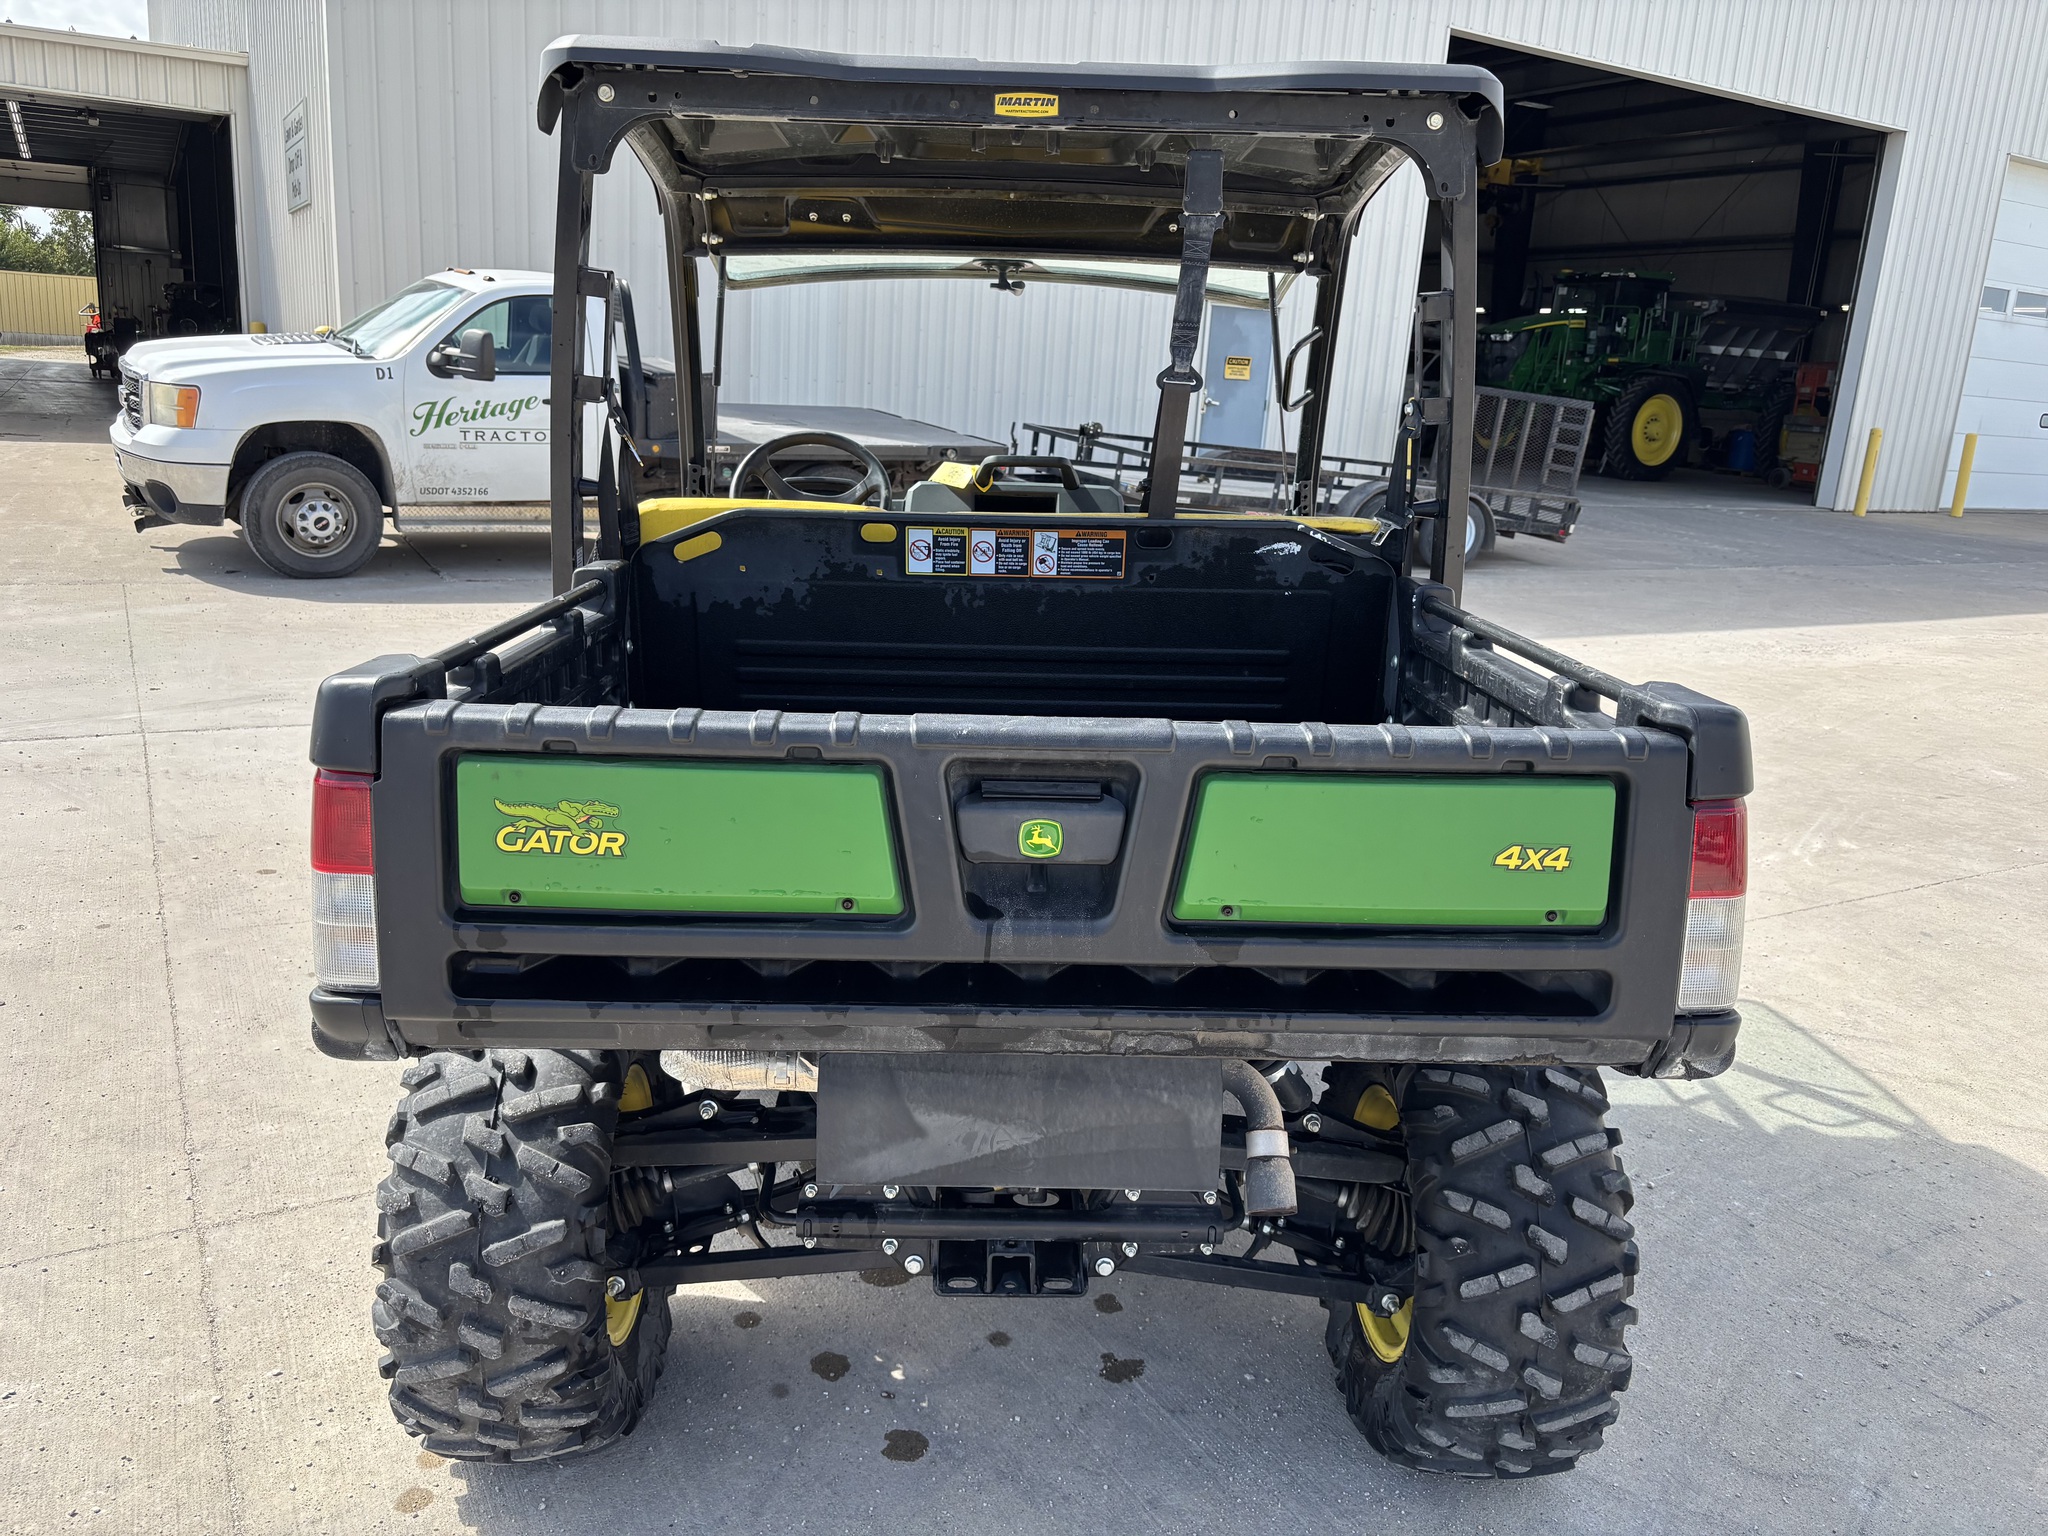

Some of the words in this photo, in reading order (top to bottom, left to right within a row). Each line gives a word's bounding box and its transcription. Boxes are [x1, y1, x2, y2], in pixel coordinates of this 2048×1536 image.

[998, 97, 1056, 106] MARTIN
[376, 367, 394, 380] D1
[410, 396, 540, 437] Heritage
[460, 430, 547, 442] TRACTO
[451, 487, 489, 496] 4352166
[496, 825, 626, 857] GATOR
